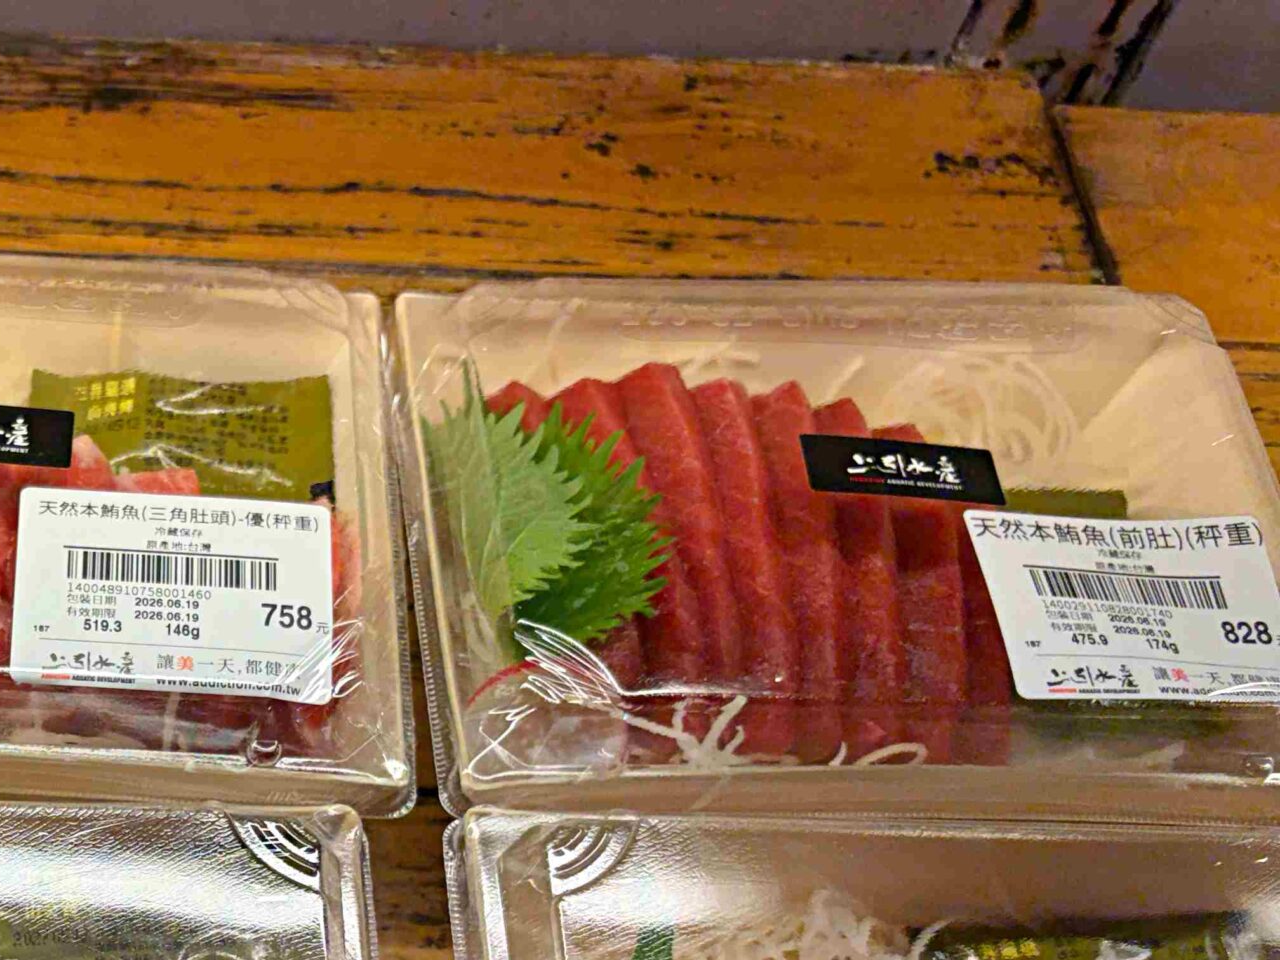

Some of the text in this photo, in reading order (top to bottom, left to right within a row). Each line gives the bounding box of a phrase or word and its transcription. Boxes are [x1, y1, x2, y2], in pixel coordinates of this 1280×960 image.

[970, 516, 1264, 551] 天然本鮪魚(前肚)(秤重)
[68, 582, 211, 600] 140048910758001460
[67, 594, 200, 610] 包裝日期 2026.06.19
[134, 610, 200, 623] 2026.06.19
[261, 603, 313, 631] 758
[83, 619, 122, 633] 519.3
[166, 625, 200, 640] 146g
[1221, 621, 1273, 645] 828
[1071, 633, 1108, 646] 475.9
[1147, 638, 1180, 655] 174g
